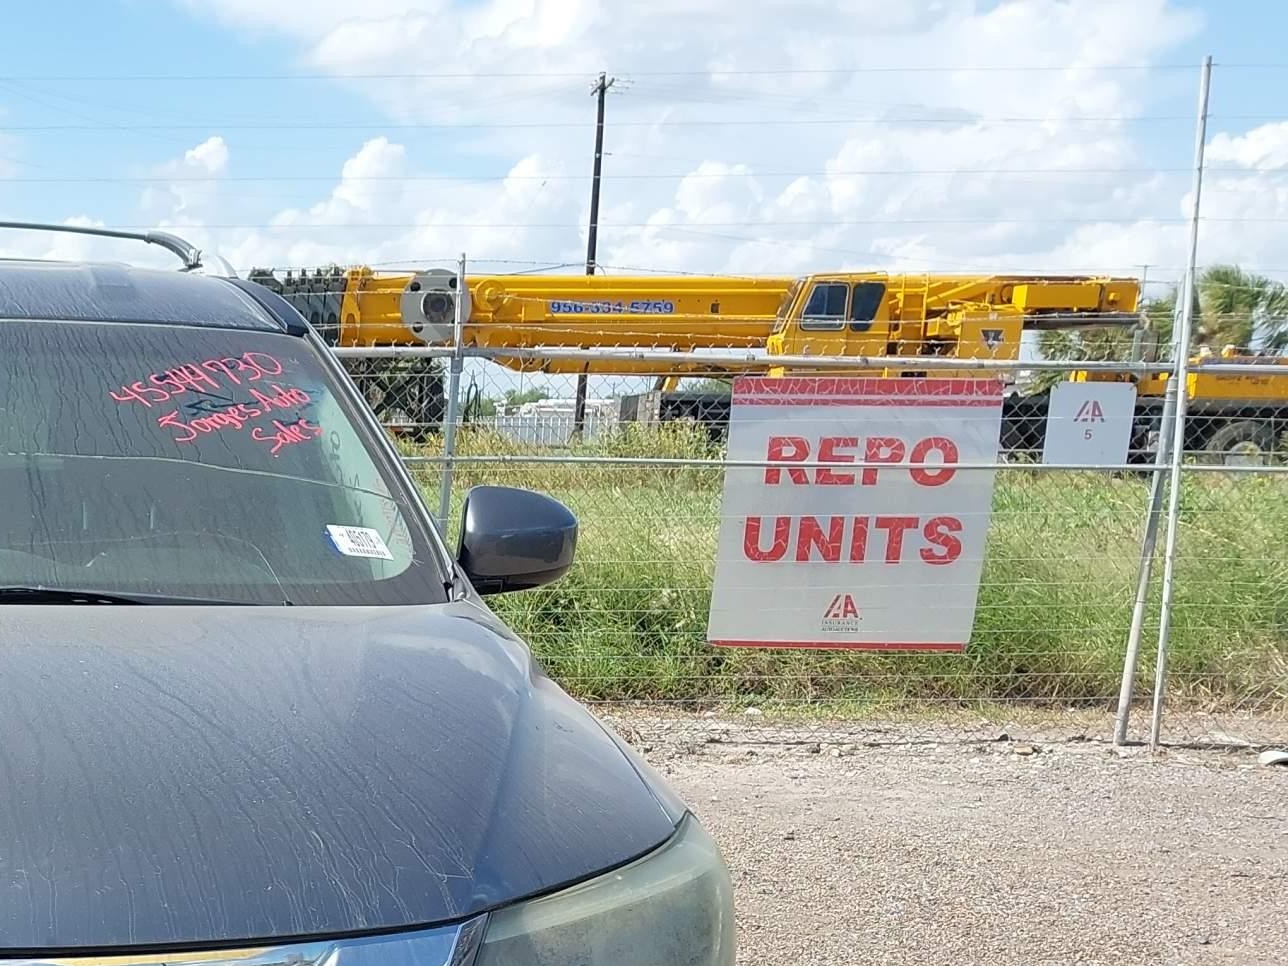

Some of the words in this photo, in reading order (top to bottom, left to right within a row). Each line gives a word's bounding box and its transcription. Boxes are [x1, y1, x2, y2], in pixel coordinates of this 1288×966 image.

[1084, 429, 1092, 440] 5
[764, 436, 959, 487] REPO
[743, 516, 963, 566] UNITS
